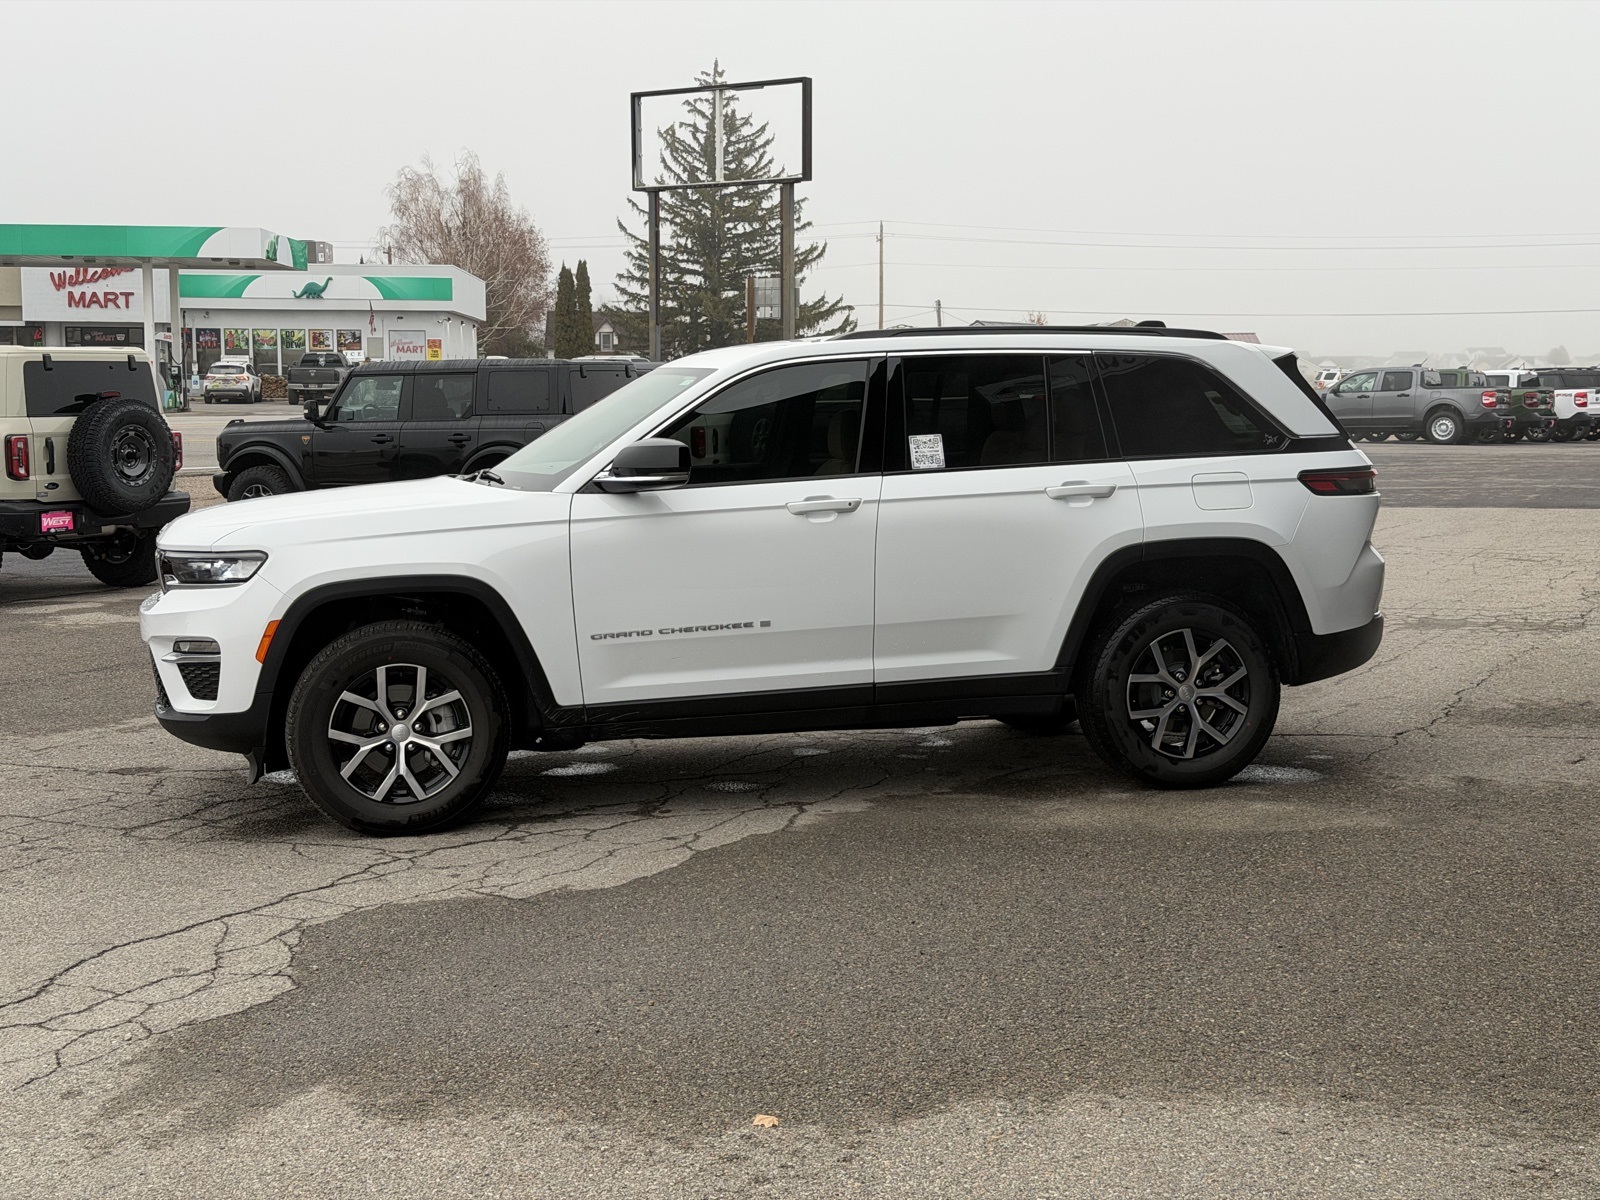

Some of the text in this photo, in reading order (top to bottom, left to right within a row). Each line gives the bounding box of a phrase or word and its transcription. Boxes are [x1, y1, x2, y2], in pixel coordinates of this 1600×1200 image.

[68, 291, 134, 309] MART
[285, 341, 302, 349] DEW
[396, 345, 425, 354] MART
[42, 516, 72, 527] WEST
[590, 621, 755, 641] GRAND CHEROKEE
